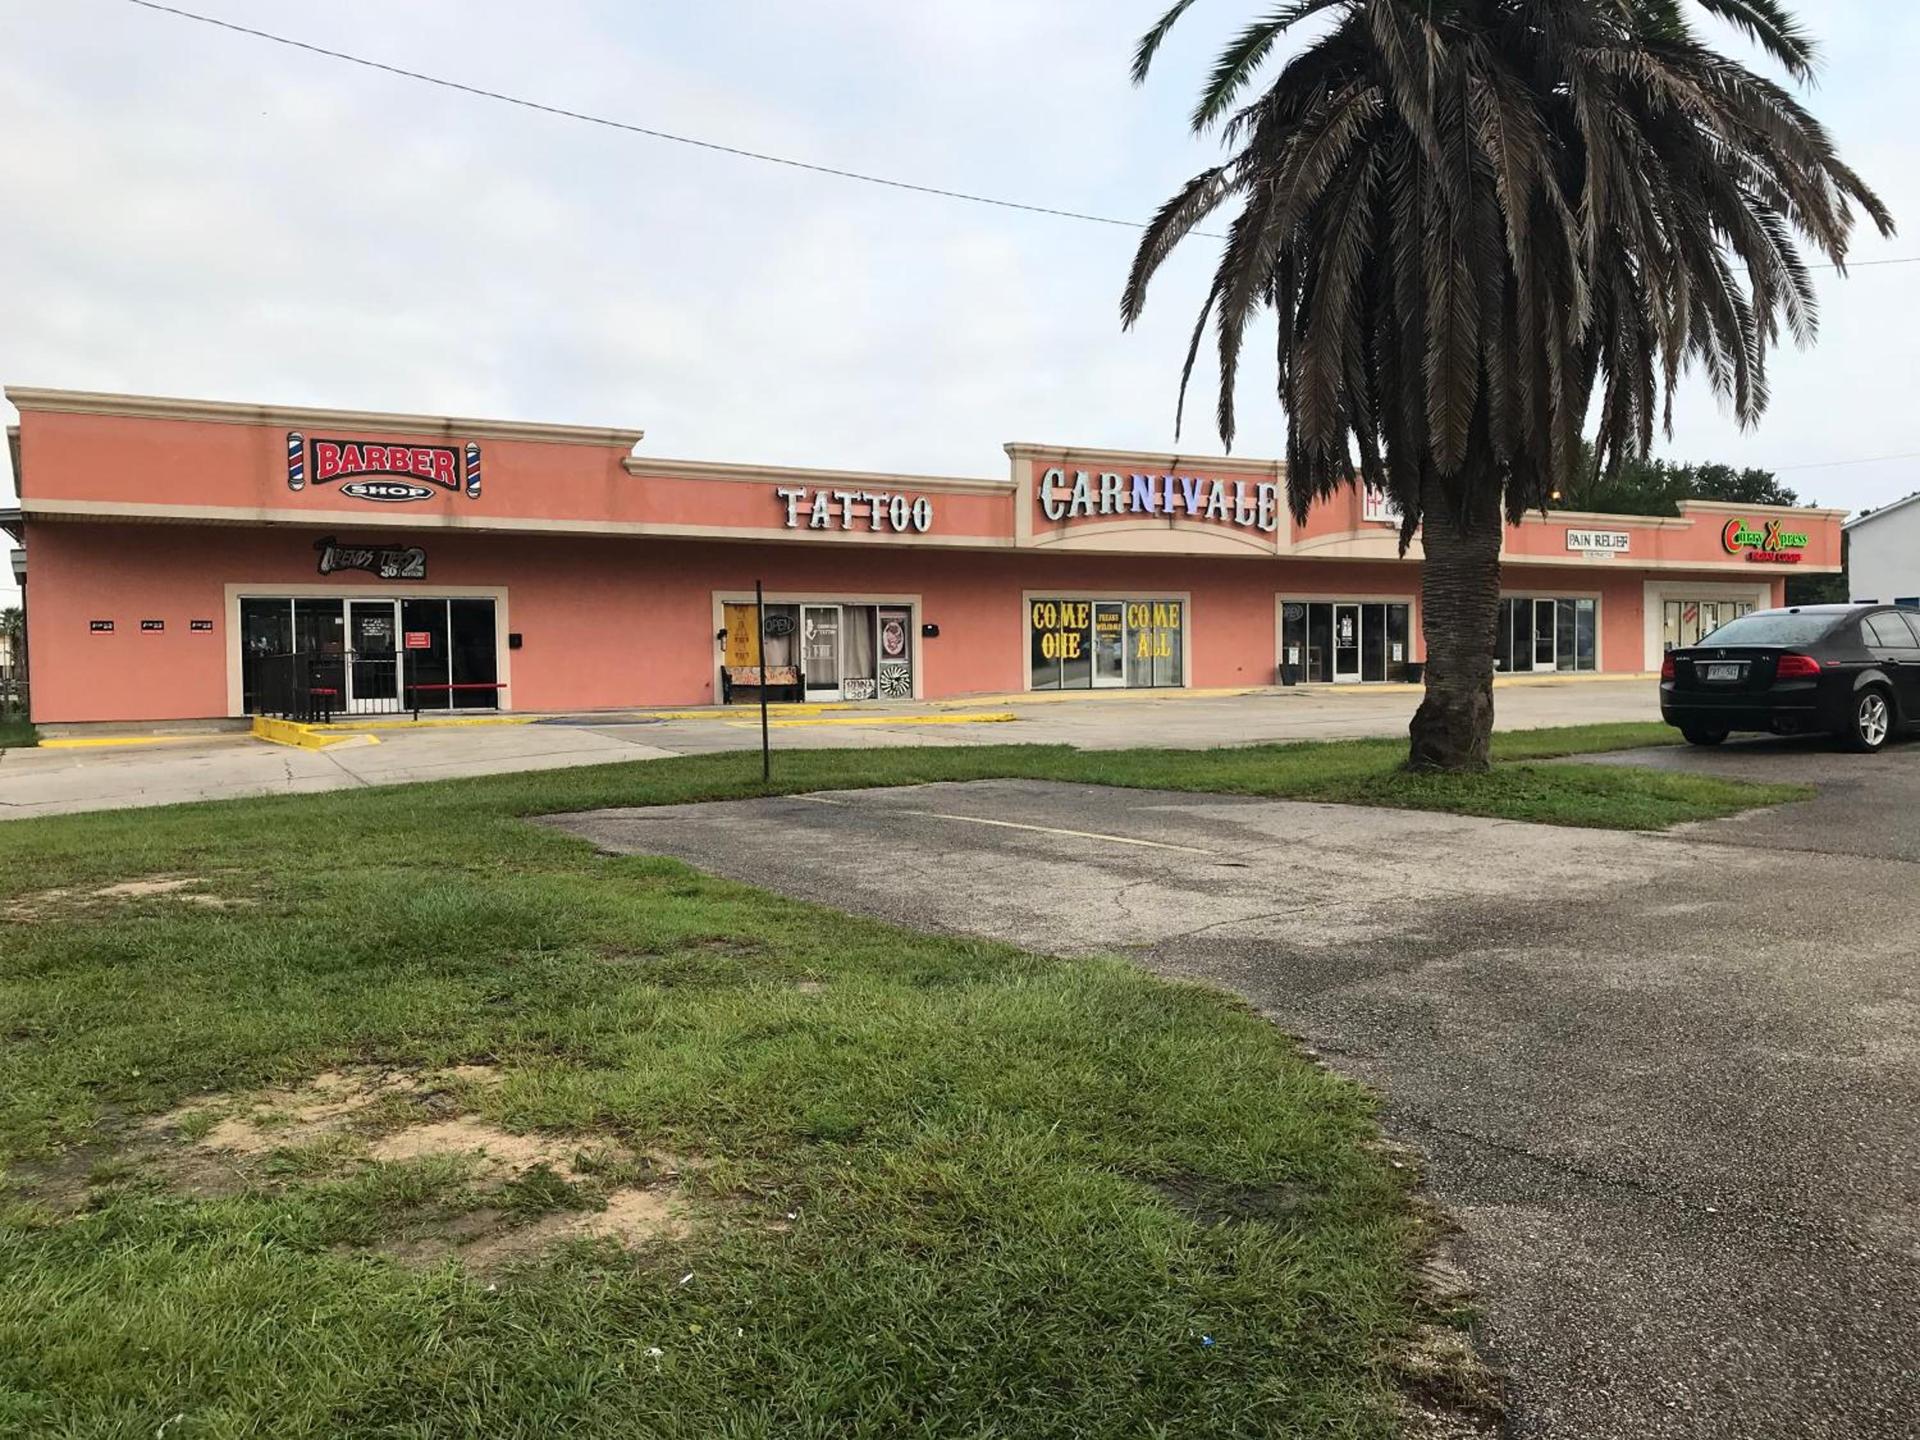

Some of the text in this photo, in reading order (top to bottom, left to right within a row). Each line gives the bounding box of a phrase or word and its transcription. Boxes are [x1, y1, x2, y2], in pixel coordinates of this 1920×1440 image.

[316, 443, 457, 486] BARBER
[350, 486, 426, 497] SHOP
[1038, 467, 1279, 532] CARNIVALE
[776, 486, 933, 532] TATTOO
[1568, 533, 1628, 548] PAIN RELIEF
[1032, 603, 1089, 629] COME
[1127, 603, 1180, 629] COME
[1041, 632, 1081, 659] ONE
[1137, 632, 1171, 658] ALL
